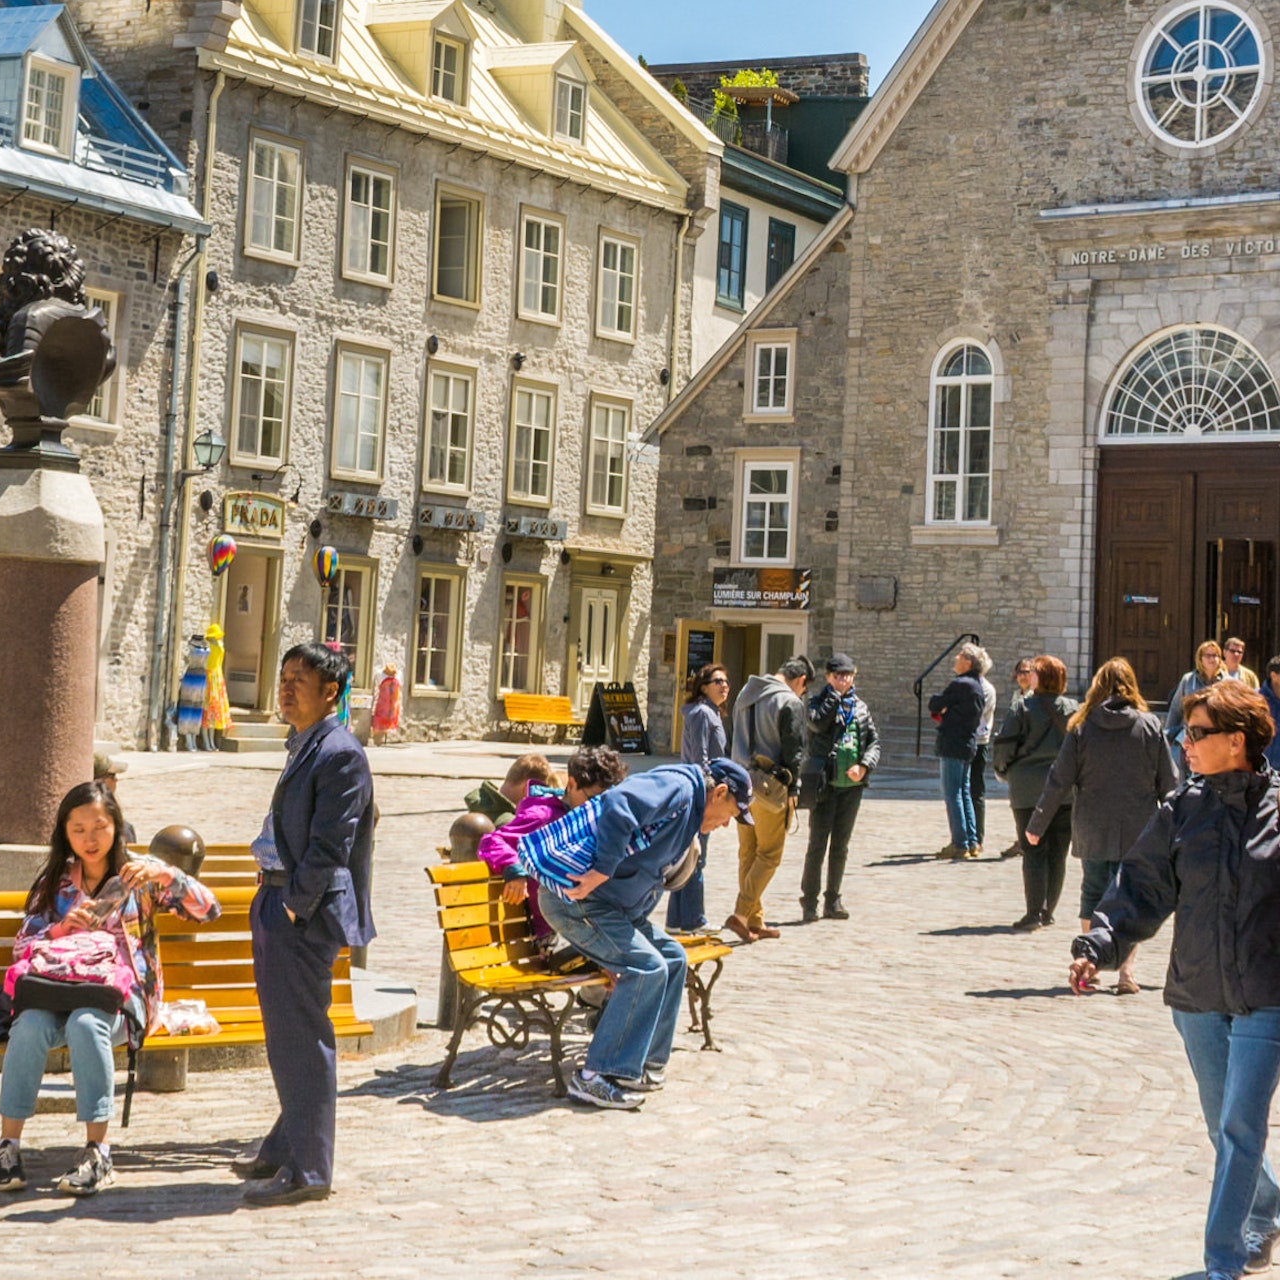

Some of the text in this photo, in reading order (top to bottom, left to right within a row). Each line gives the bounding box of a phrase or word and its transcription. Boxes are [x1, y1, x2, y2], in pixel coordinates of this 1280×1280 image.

[1071, 247, 1166, 266] NOTRE-DAME
[1181, 244, 1212, 259] DES
[746, 591, 762, 600] SUR
[763, 591, 809, 601] CHAMPLAIN
